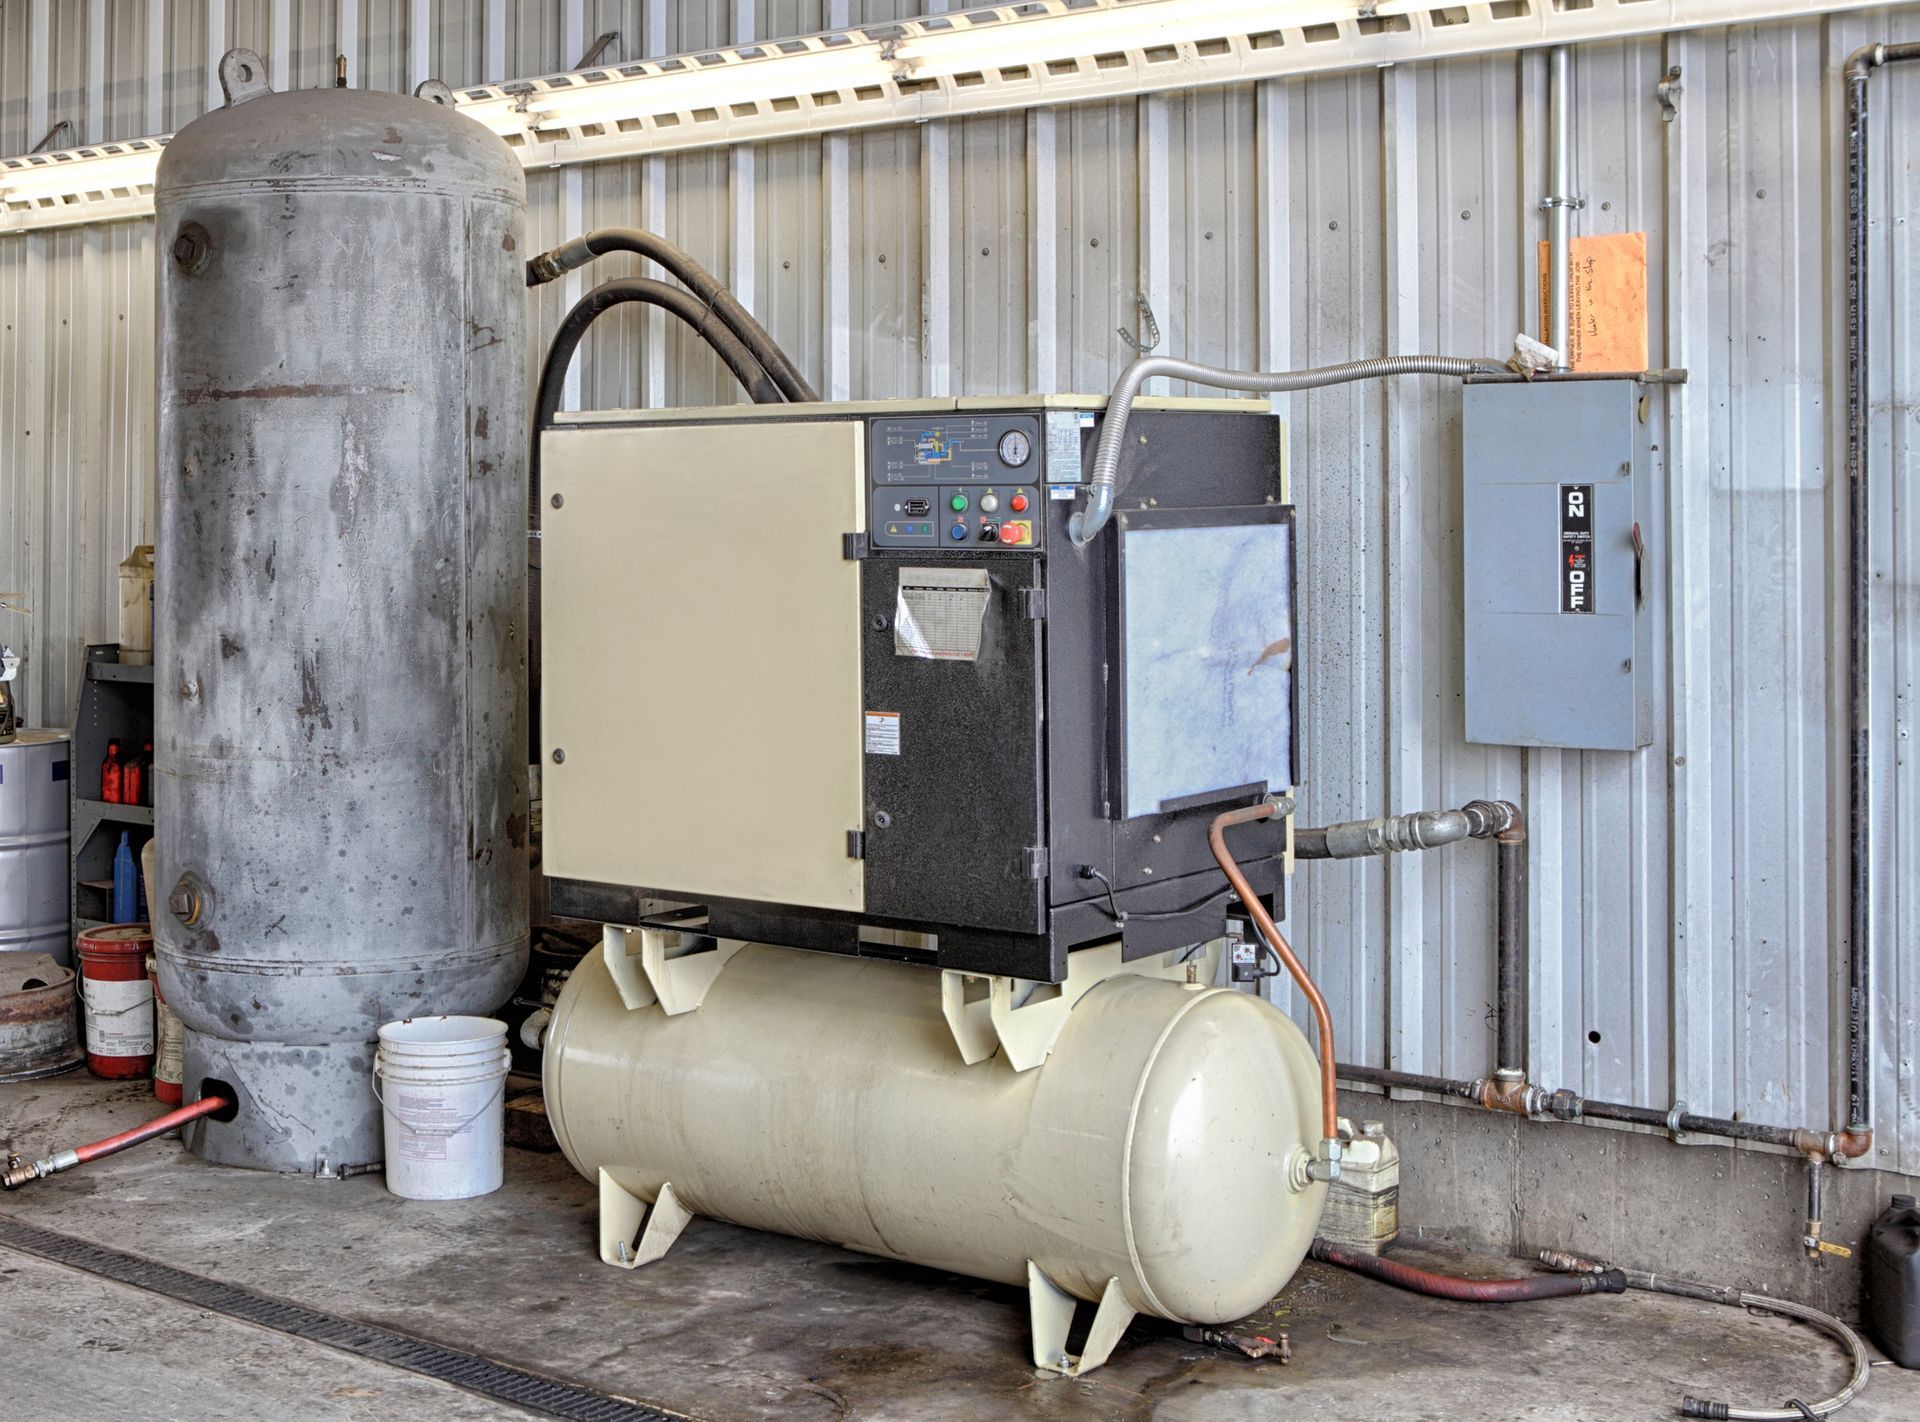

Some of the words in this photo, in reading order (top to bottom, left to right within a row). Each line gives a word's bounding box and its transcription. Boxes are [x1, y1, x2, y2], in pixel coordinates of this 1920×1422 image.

[1582, 256, 1596, 275] Shop
[1568, 491, 1584, 517] ON
[1569, 570, 1585, 608] OFF
